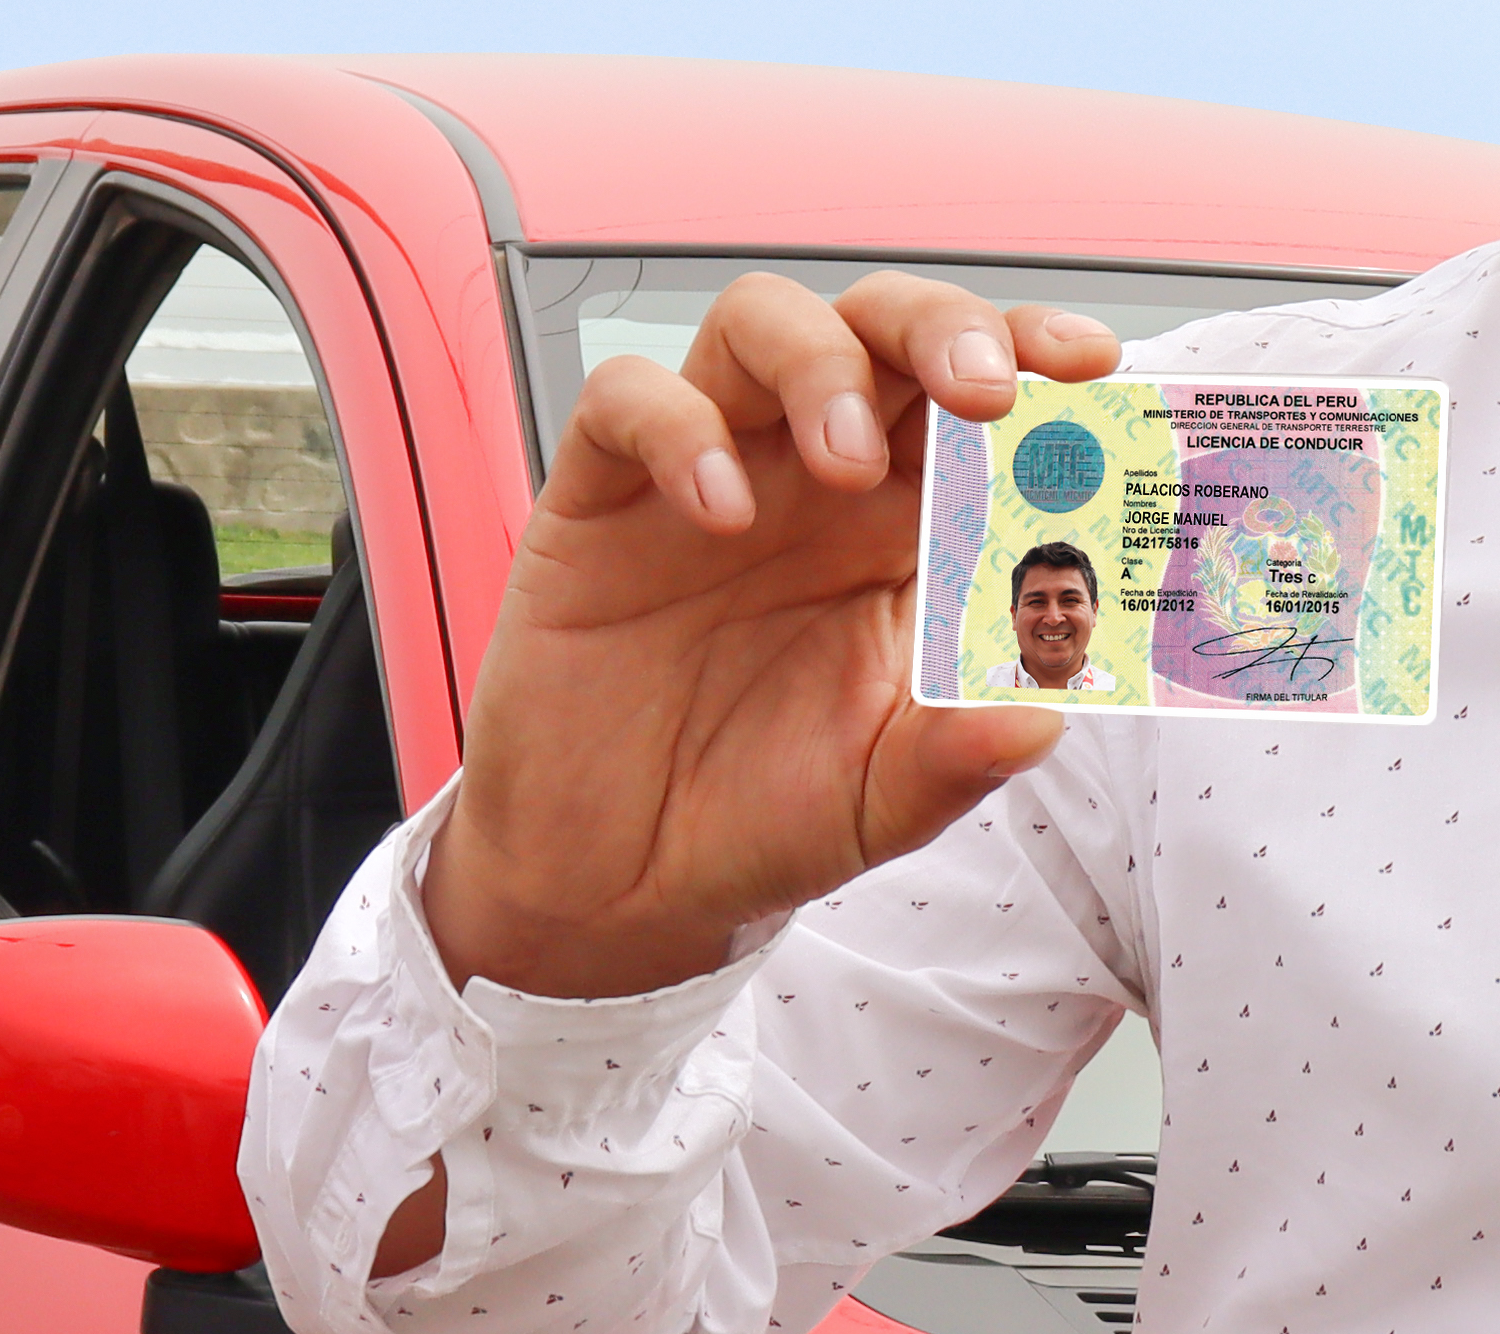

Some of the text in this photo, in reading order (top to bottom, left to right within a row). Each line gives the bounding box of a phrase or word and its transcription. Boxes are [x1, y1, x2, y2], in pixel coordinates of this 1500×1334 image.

[1195, 393, 1357, 408] REPUBLICA DEL PERU
[1143, 409, 1419, 423] MINISTERIO DE TRANSPORTES Y COMUNICACIONES
[1170, 421, 1387, 433] DIRECCION GENERAL DE TRANSPORTE TERRESTRE
[1187, 436, 1363, 450] LICENCIA DE CONDUCIR
[1027, 443, 1086, 489] MTC
[1123, 469, 1158, 478] Apellidos
[1125, 483, 1269, 499] PALACIOS ROBERANO
[1123, 500, 1157, 508] Nombres
[1124, 511, 1228, 527] JORGE MANUEL
[1122, 526, 1181, 535] Nro de Licencia
[1122, 536, 1199, 550] D42175816
[1121, 557, 1143, 566] Clase
[1400, 514, 1428, 617] MTC
[1120, 568, 1132, 580] A
[1269, 569, 1303, 584] Tres
[1120, 588, 1198, 599] Fecha de Expedición
[1265, 590, 1349, 599] Fecha de Revalidación
[1120, 598, 1195, 612] 16/01/2012
[1265, 600, 1340, 614] 16/01/2015
[1246, 693, 1328, 702] FIRMA DEL TITULAR
